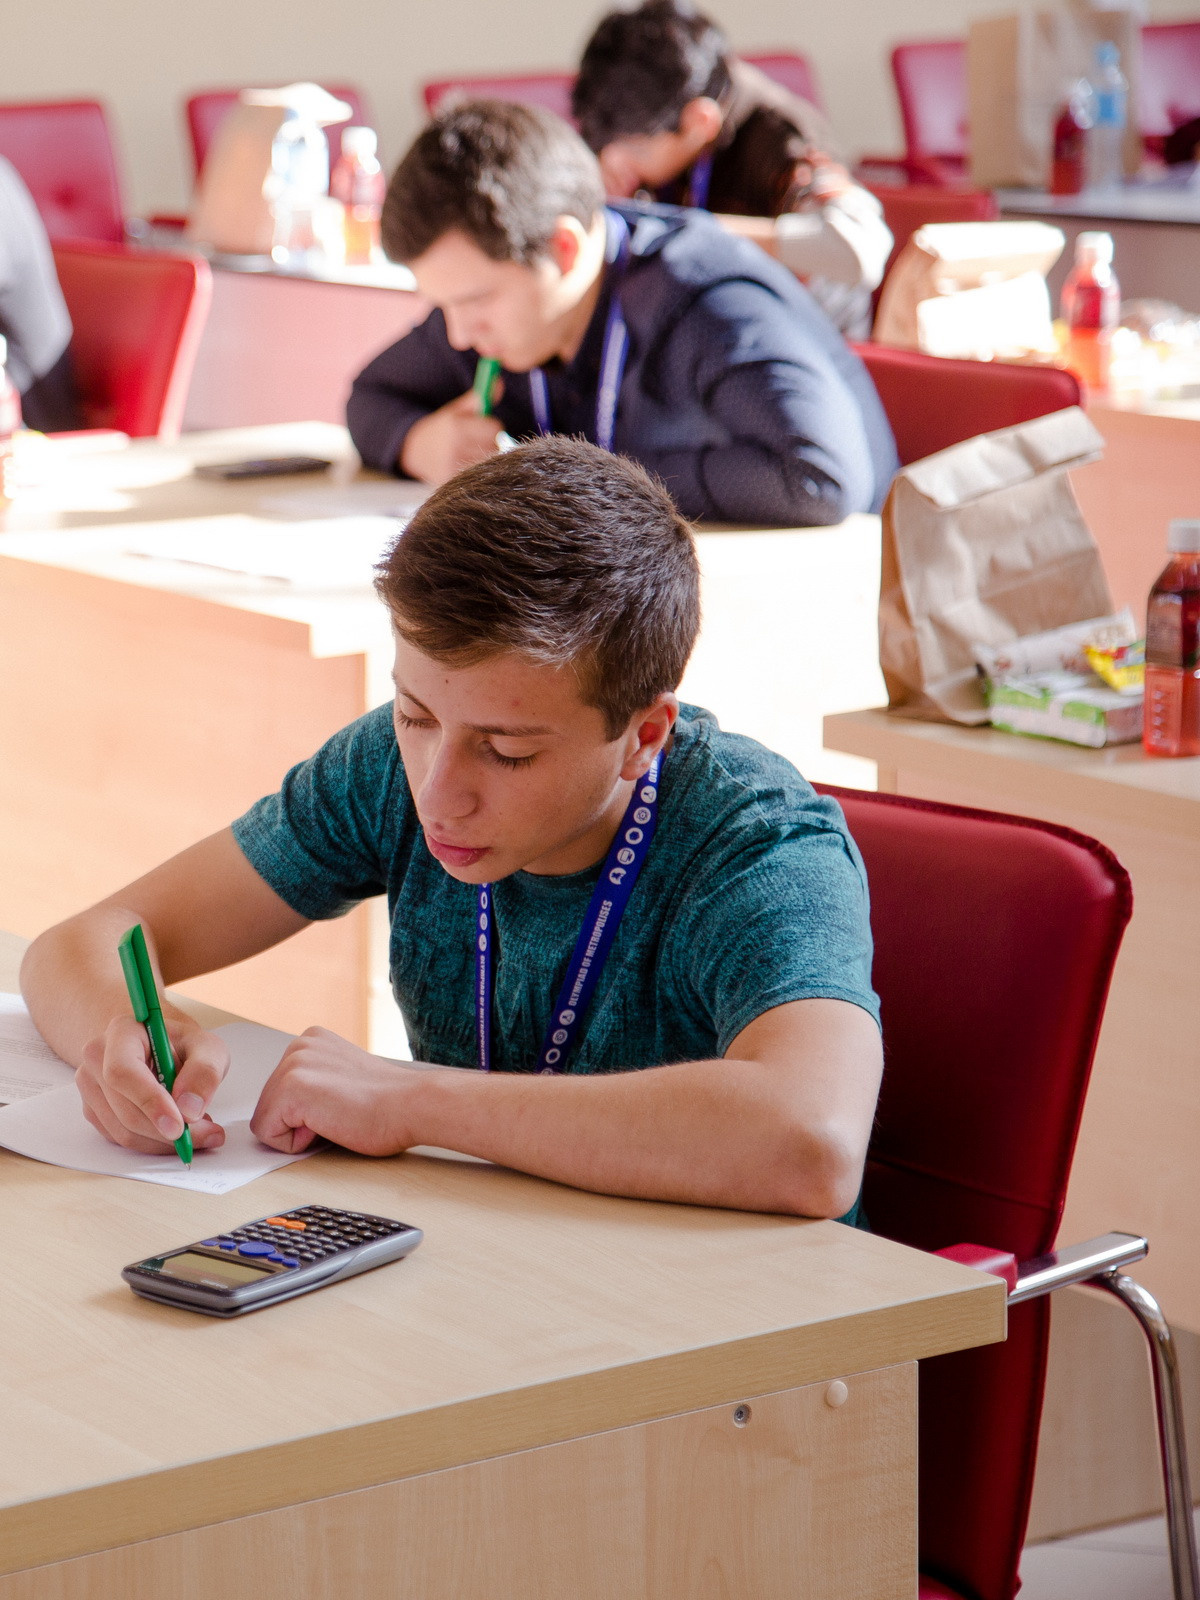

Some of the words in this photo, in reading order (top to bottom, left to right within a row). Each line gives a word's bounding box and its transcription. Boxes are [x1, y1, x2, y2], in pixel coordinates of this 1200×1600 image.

[585, 900, 612, 957] METROPOLISES
[581, 956, 592, 967] OF
[569, 968, 587, 1006] OLYMPIAD
